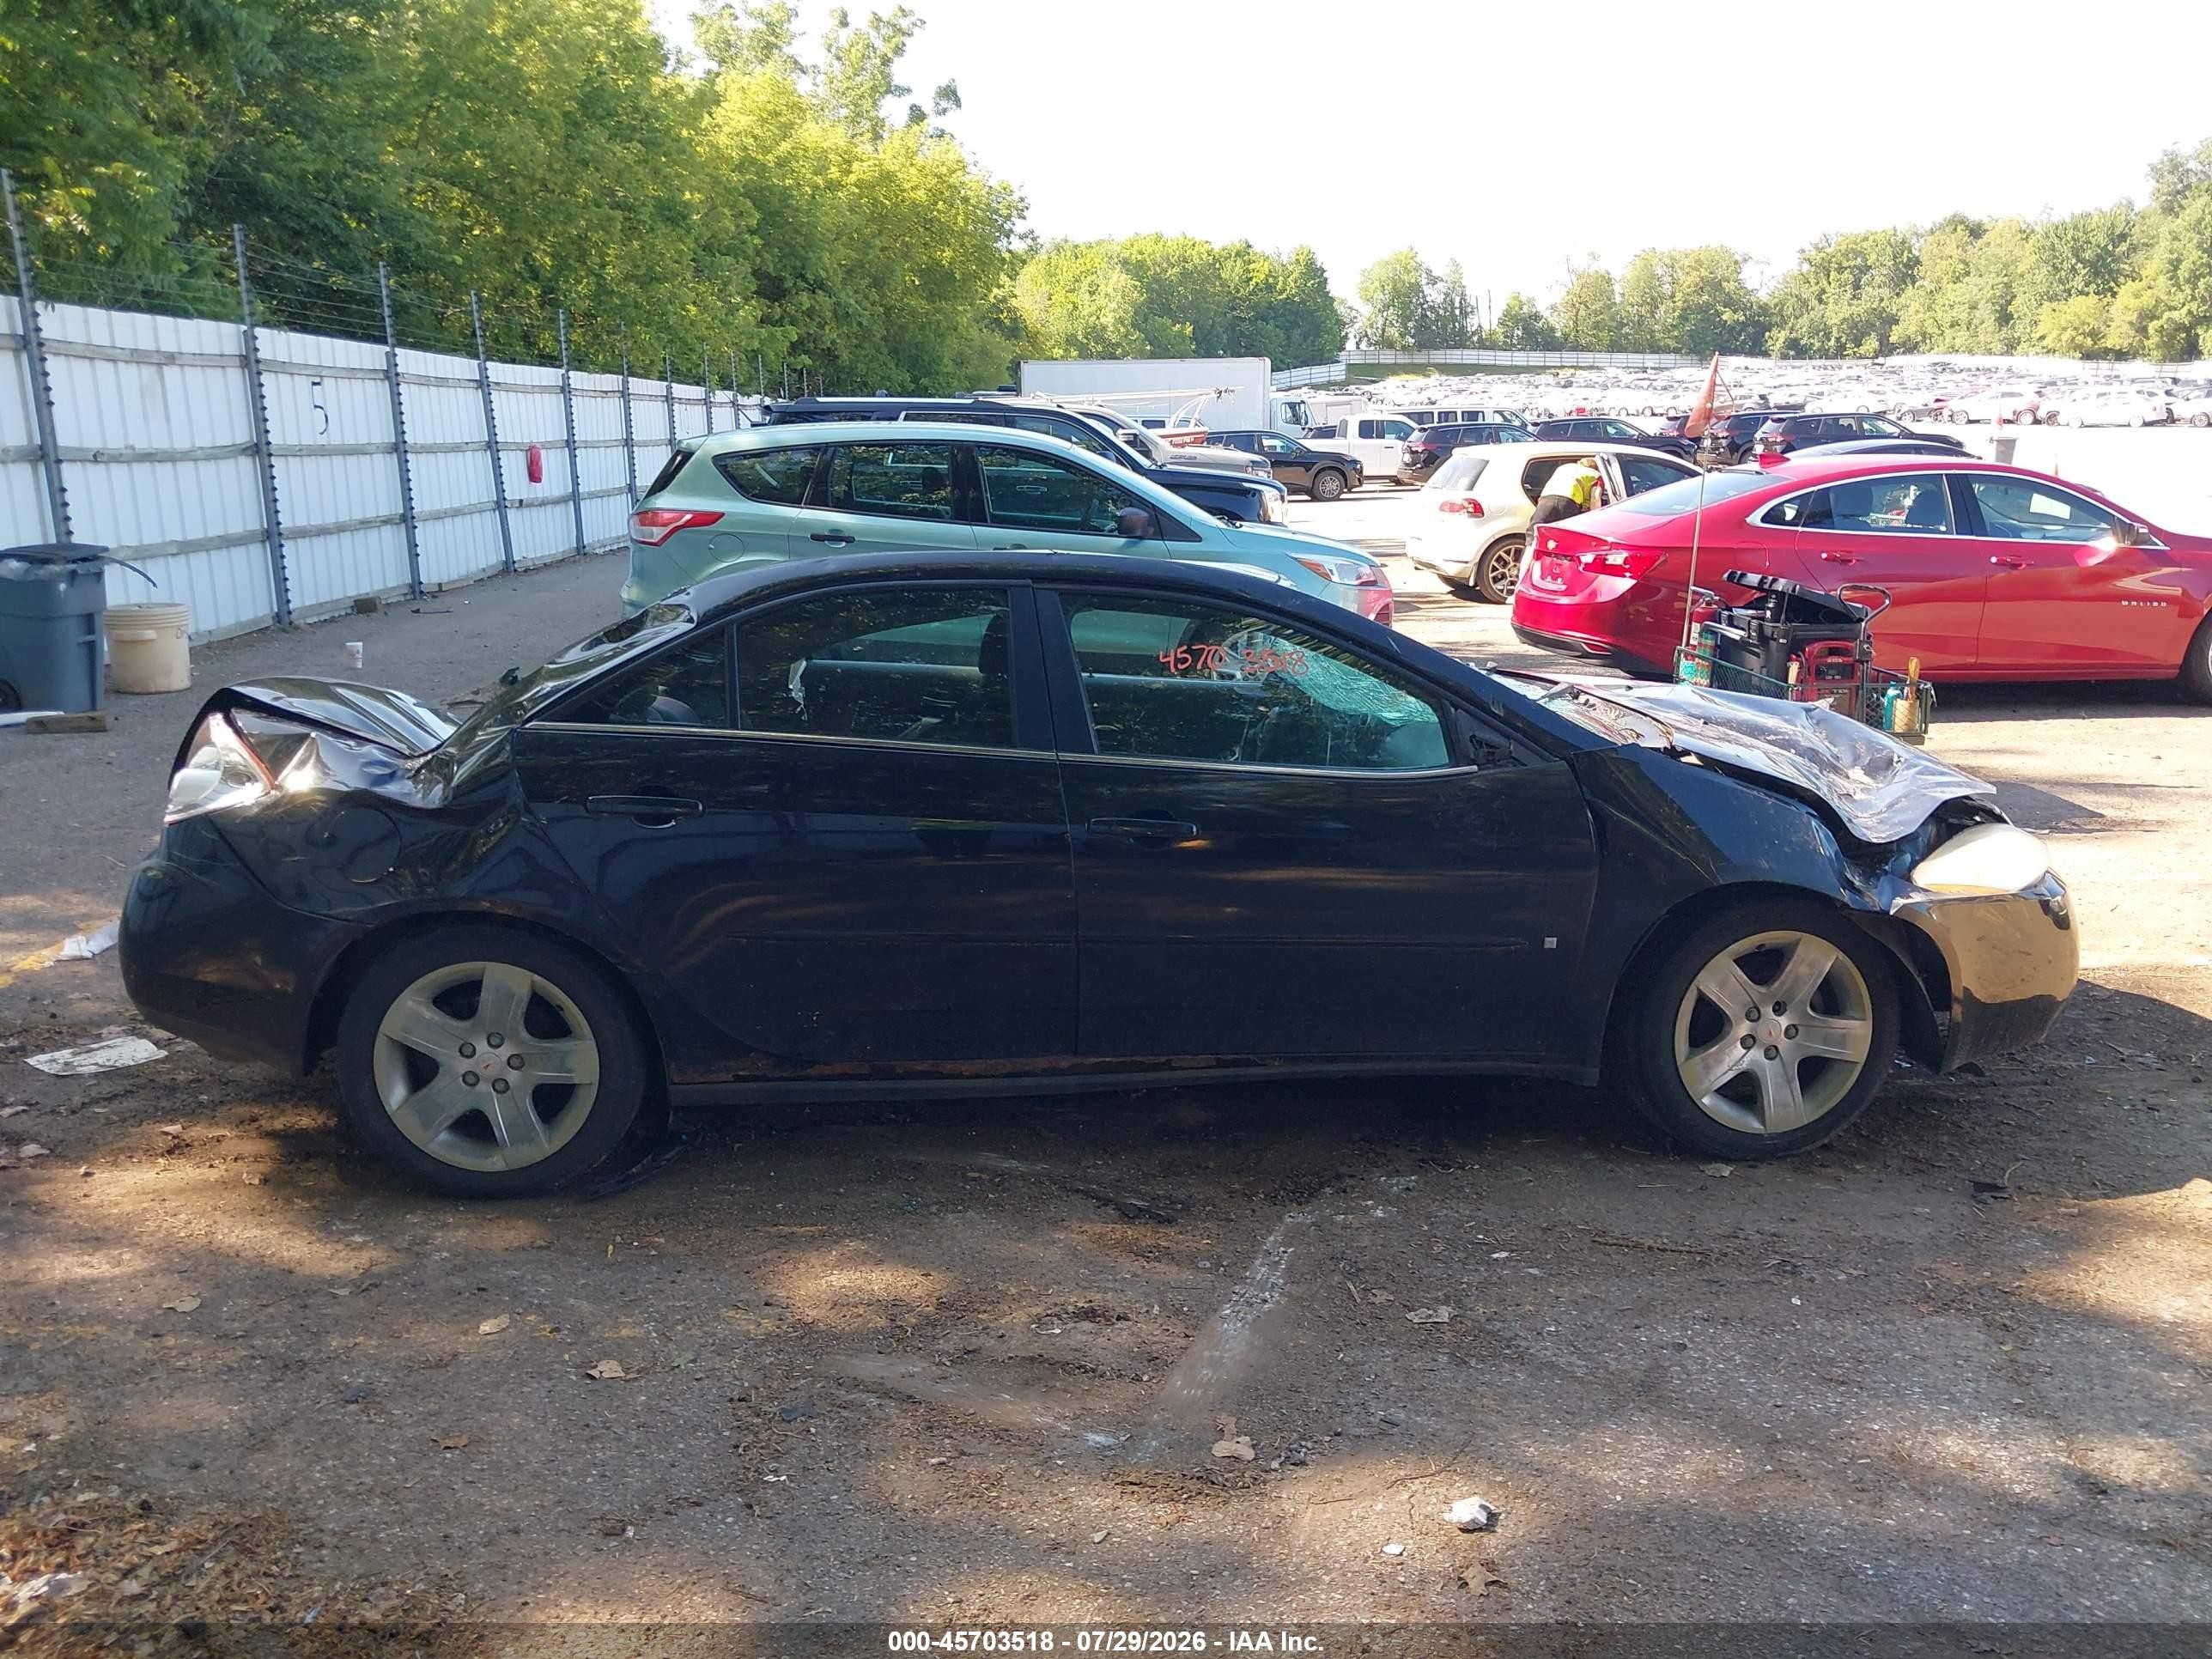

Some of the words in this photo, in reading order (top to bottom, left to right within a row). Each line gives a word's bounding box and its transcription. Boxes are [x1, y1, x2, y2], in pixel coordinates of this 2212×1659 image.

[310, 380, 329, 435] 5
[1158, 645, 1226, 674] 4570
[1239, 647, 1309, 675] 3518
